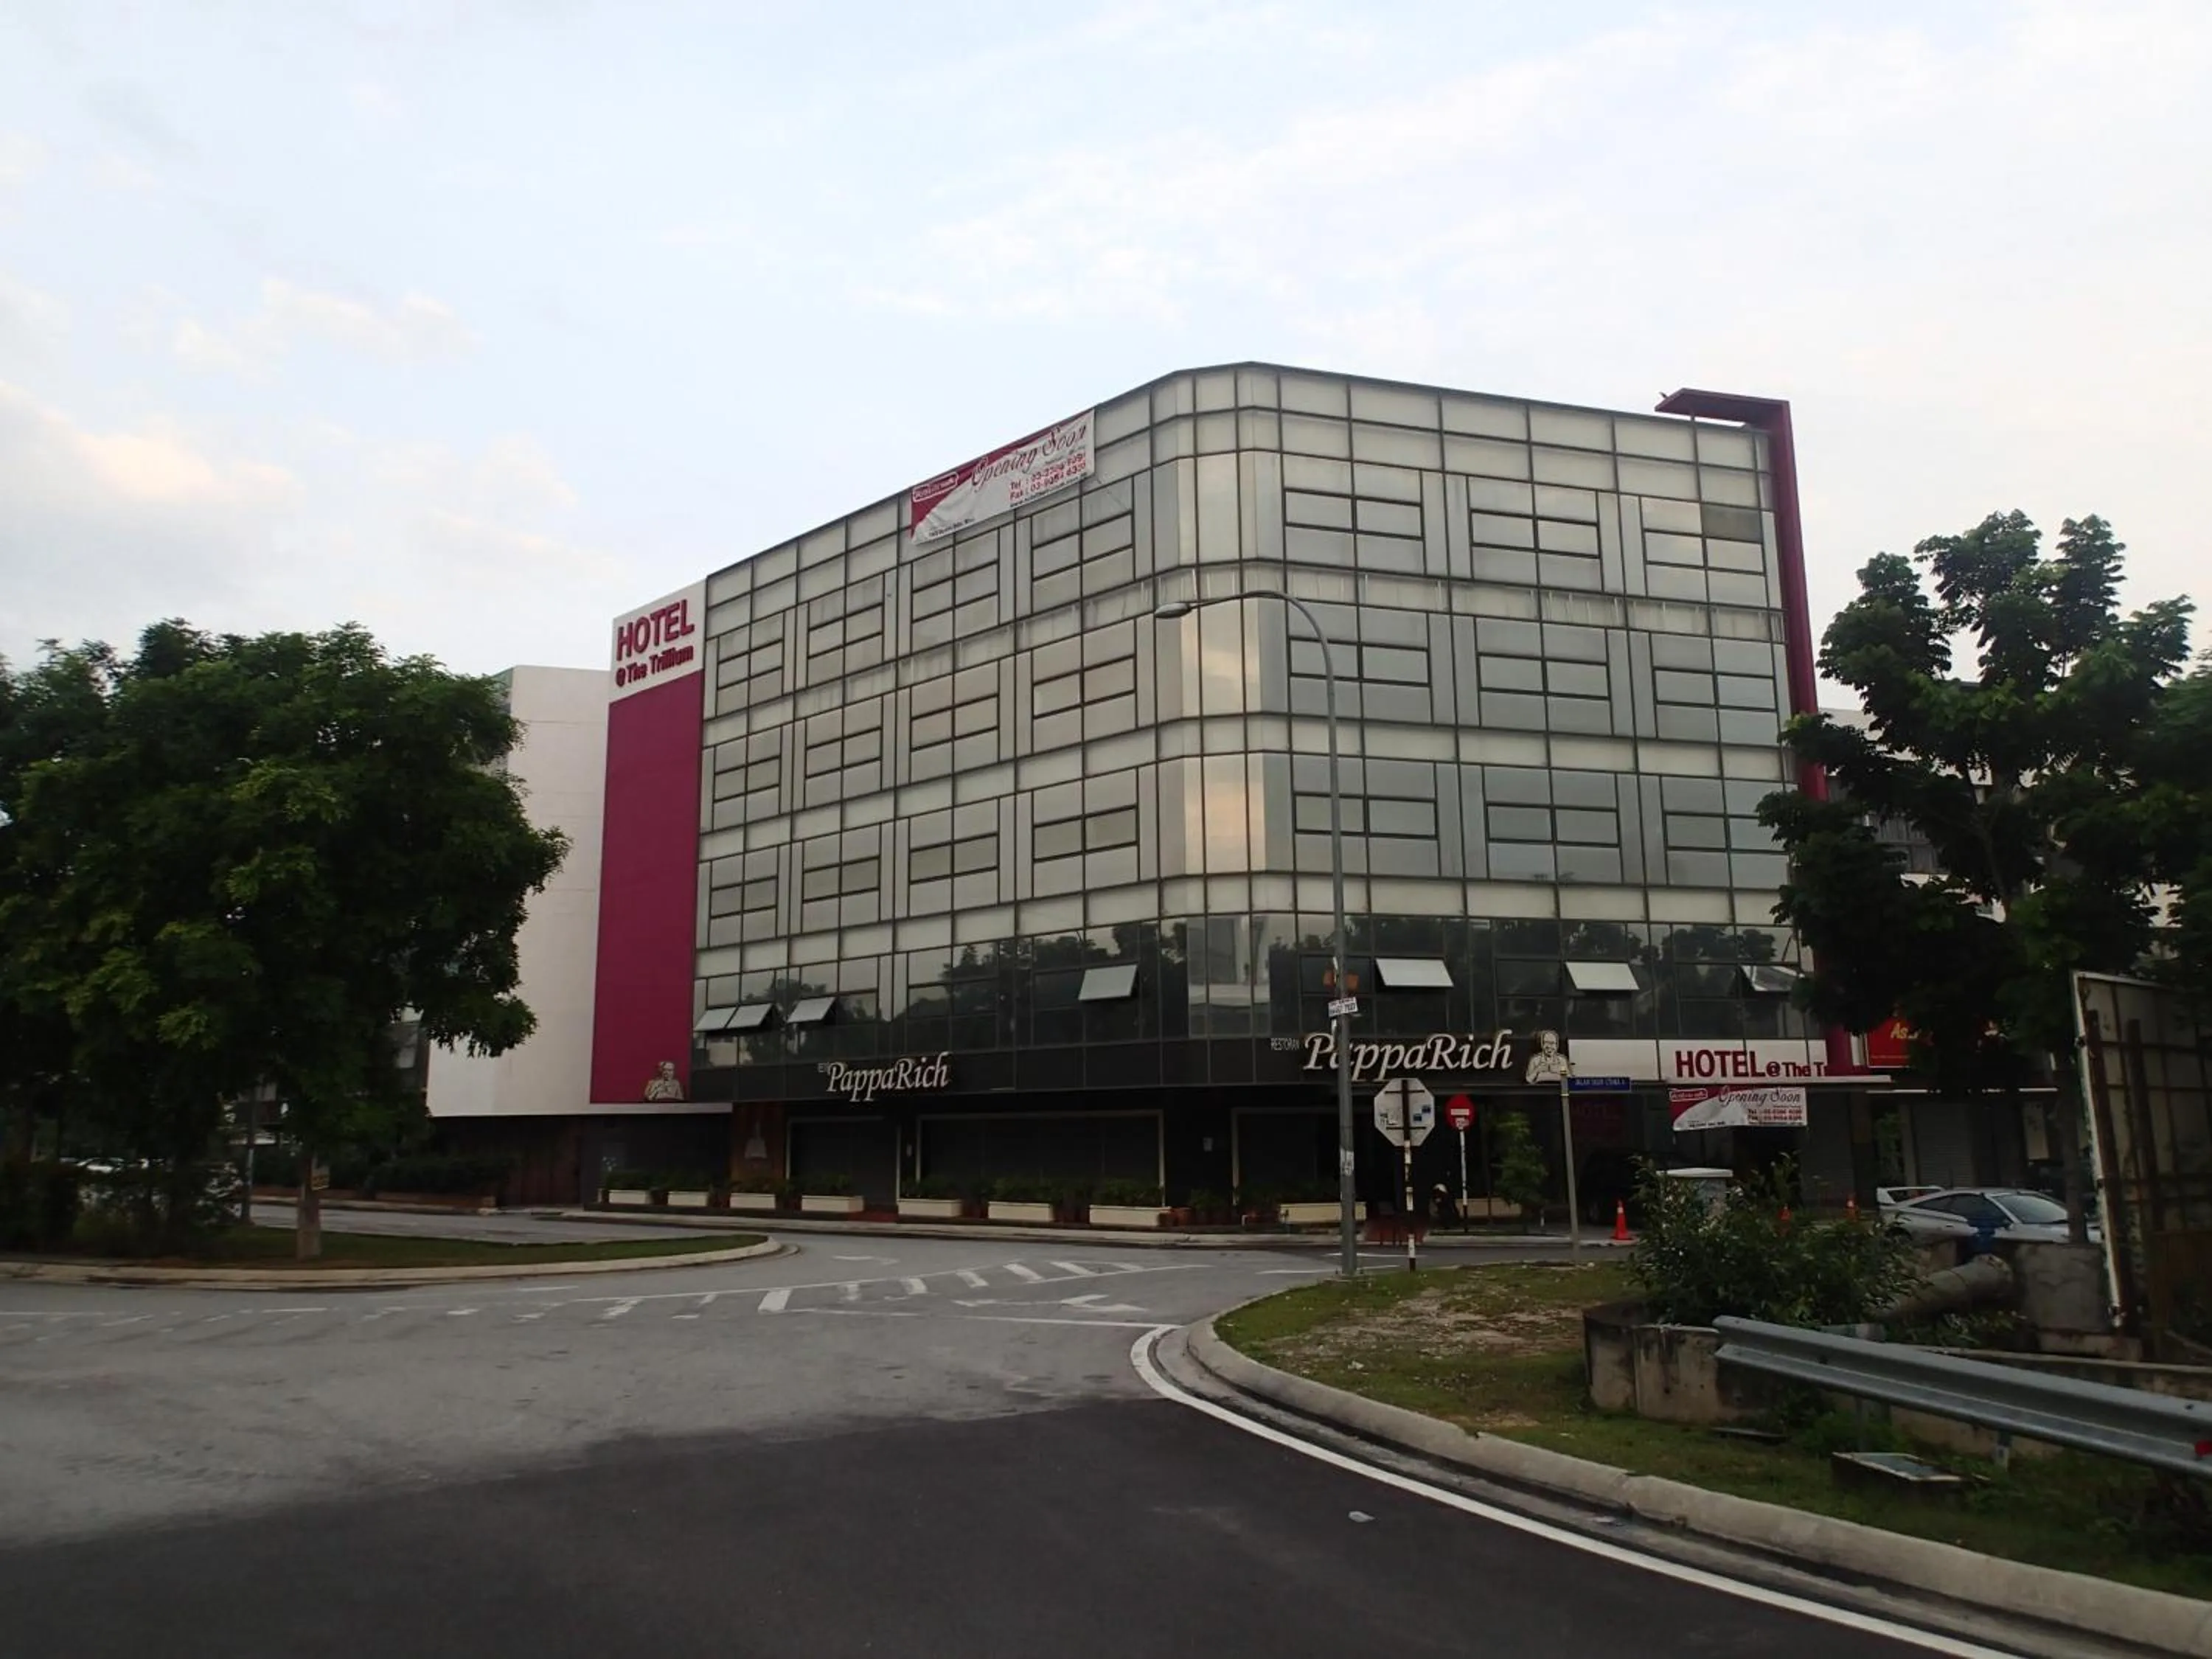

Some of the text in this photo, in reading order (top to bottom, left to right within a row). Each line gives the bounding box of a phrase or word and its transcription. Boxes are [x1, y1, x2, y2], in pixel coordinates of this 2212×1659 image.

[971, 449, 1038, 493] Opening
[1039, 424, 1087, 456] Soon
[616, 599, 695, 661] HOTEL
[649, 645, 694, 675] Trillium
[826, 1051, 953, 1102] PappaRich
[1303, 1029, 1513, 1082] PappaRich
[1675, 1049, 1766, 1078] HOTEL
[1717, 1085, 1767, 1107] Opening
[1770, 1087, 1801, 1102] Soon
